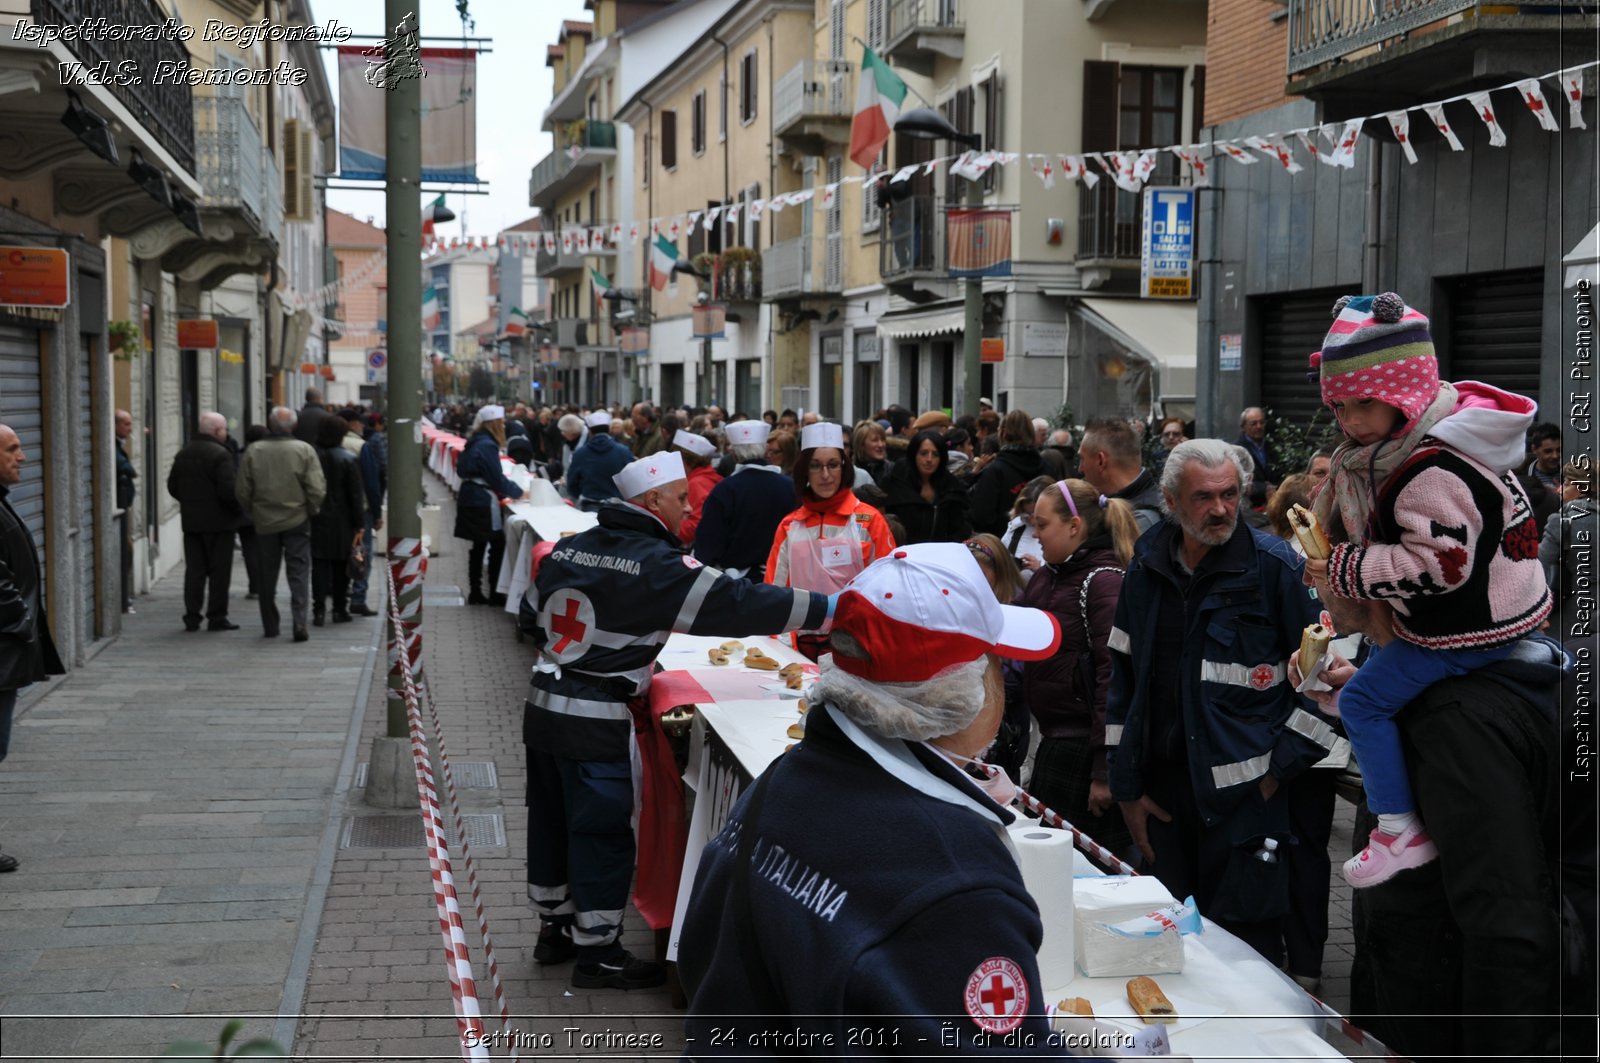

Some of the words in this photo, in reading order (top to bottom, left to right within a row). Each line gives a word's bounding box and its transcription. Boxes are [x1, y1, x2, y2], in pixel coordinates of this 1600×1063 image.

[1154, 260, 1188, 269] LOTTO
[599, 555, 641, 576] ITALIANA
[758, 842, 848, 922] ITALIANA
[967, 973, 982, 1000] CROCE
[980, 960, 1003, 975] ROSSA
[1004, 962, 1025, 994] ITALIANA
